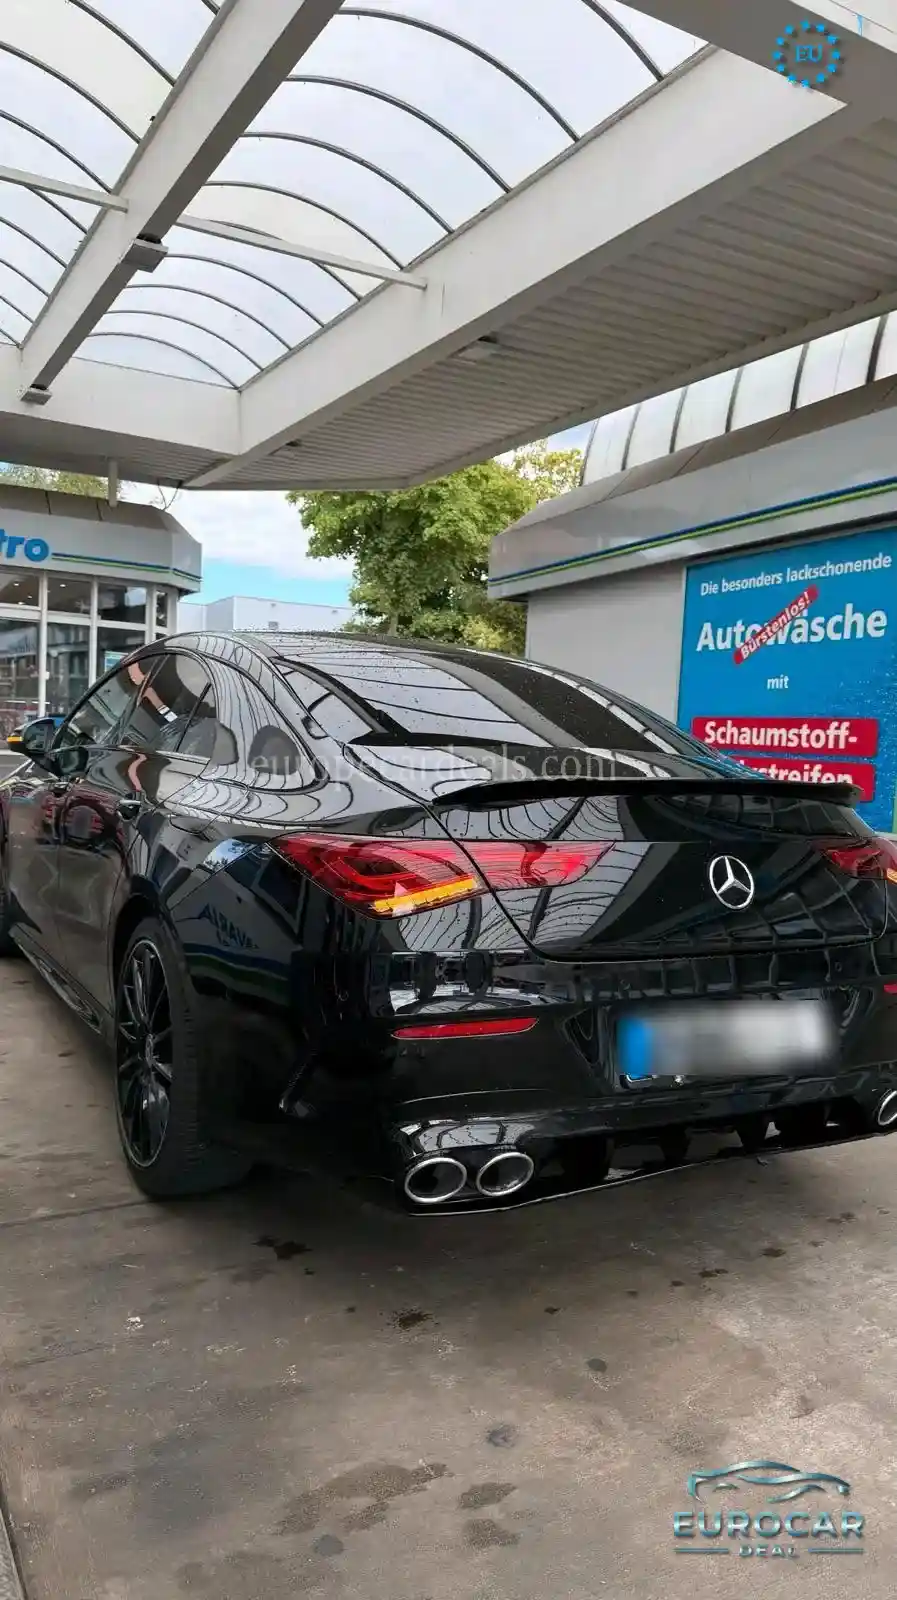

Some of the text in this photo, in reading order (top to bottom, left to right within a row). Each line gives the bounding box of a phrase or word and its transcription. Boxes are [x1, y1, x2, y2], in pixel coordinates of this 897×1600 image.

[700, 552, 892, 596] Die besonders lackschonende
[740, 590, 811, 660] Bürstenlos!
[766, 674, 790, 690] mit
[704, 720, 858, 749] Schaumstoff-
